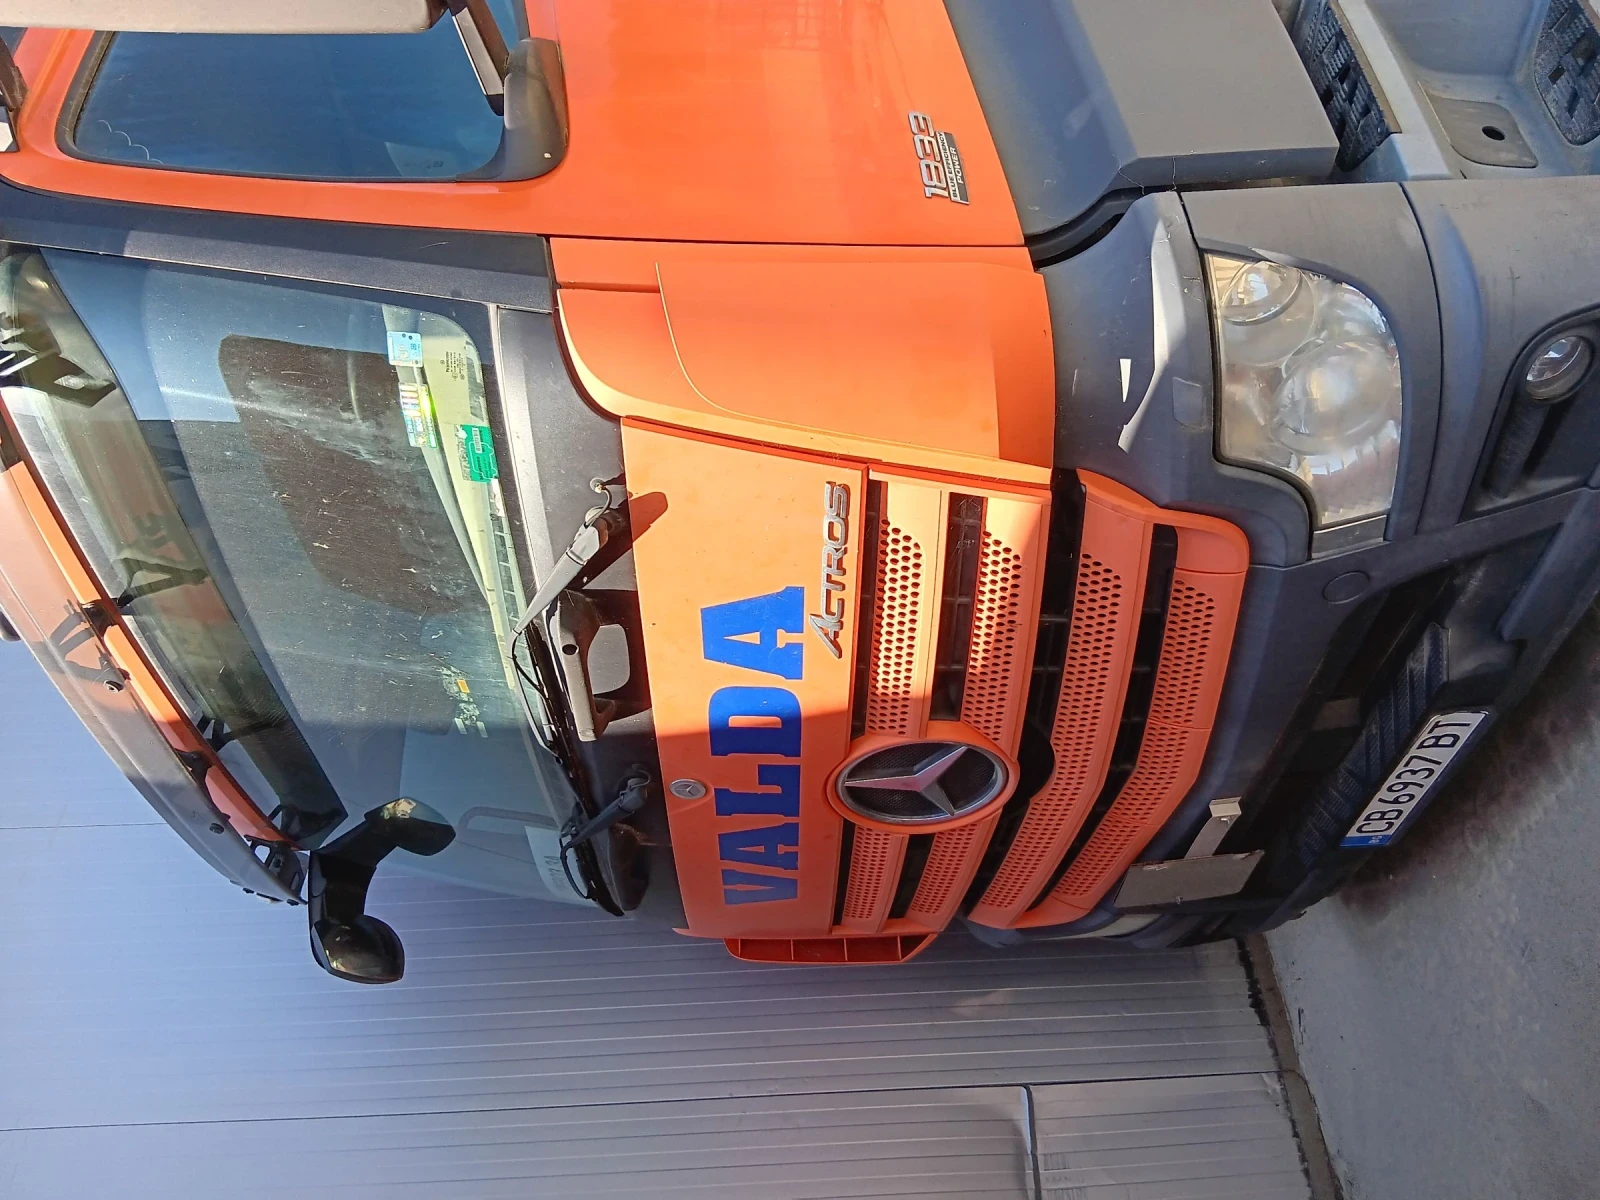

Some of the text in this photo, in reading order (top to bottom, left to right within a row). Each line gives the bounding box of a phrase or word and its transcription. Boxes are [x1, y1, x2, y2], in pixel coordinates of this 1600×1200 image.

[908, 112, 949, 198] 1833
[938, 133, 958, 197] BLUE EFFICIENCY
[950, 147, 963, 183] POWER
[701, 586, 804, 904] VALDA
[1355, 720, 1470, 833] CB 6937 BT
